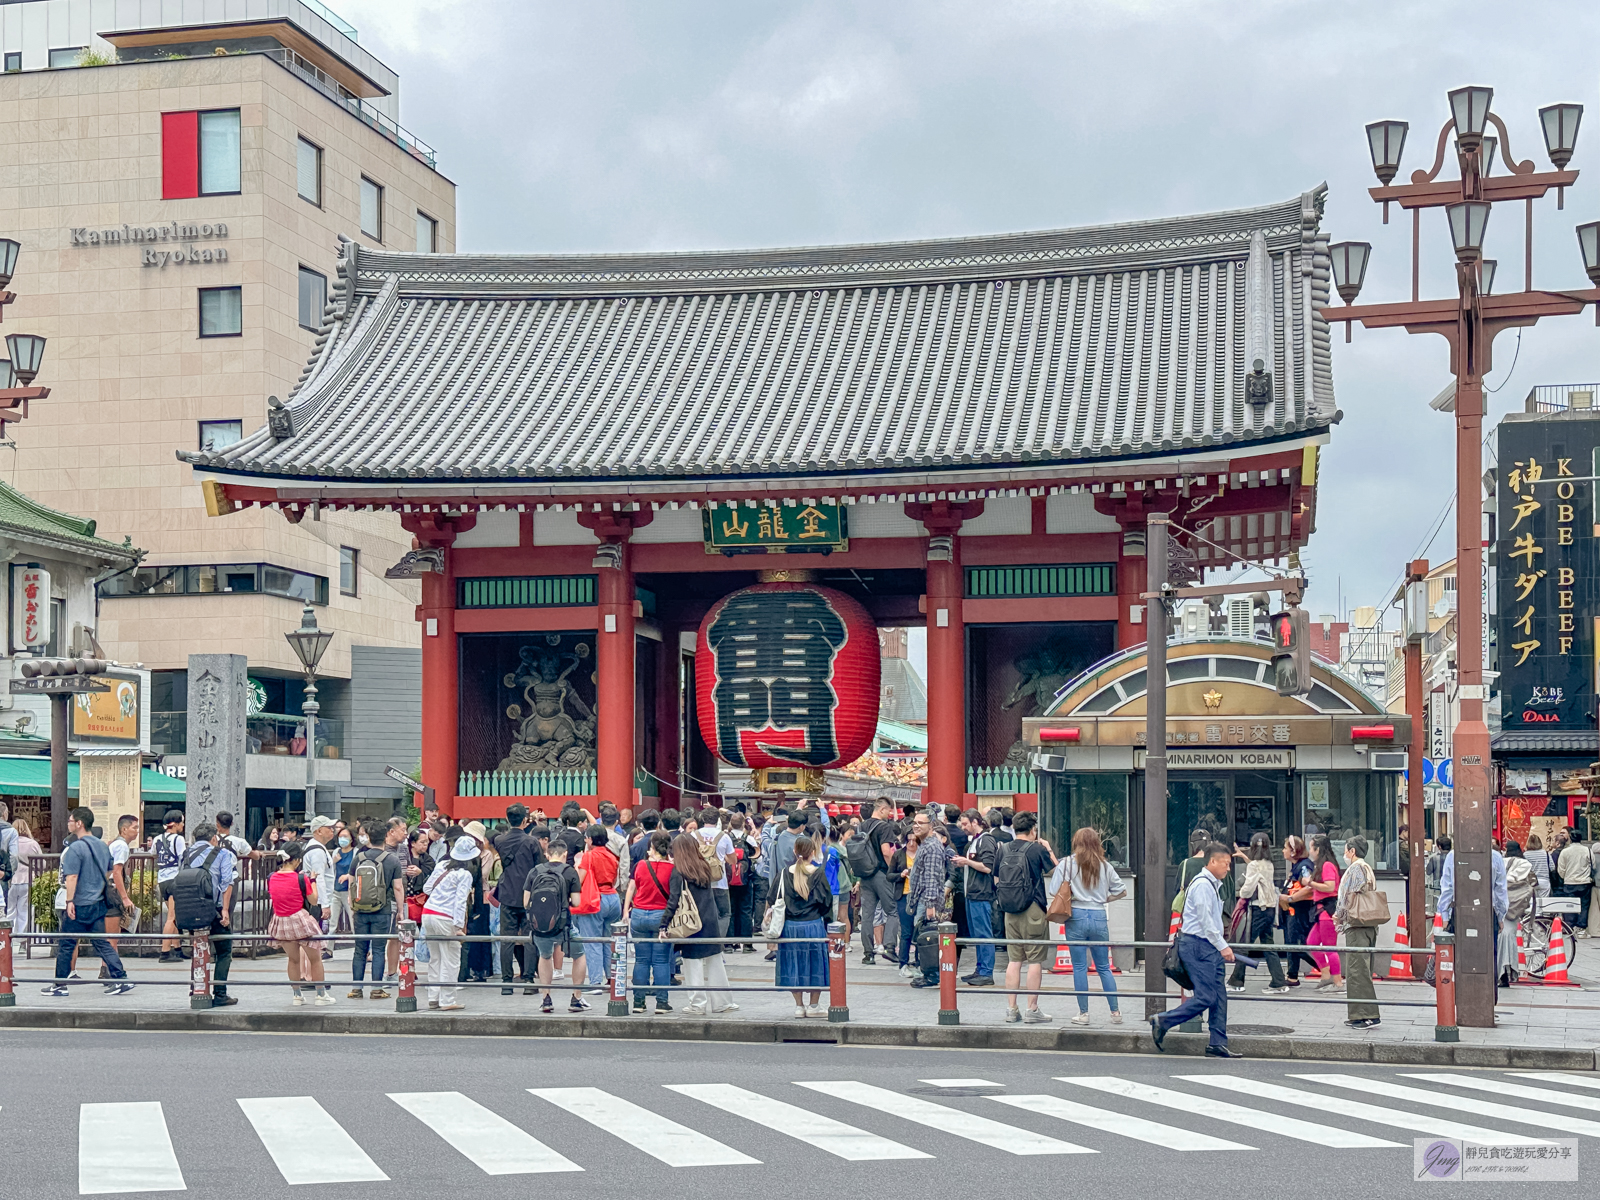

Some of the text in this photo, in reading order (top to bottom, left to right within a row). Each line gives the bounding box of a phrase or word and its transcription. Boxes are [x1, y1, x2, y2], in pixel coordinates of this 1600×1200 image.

[69, 220, 229, 246] Kaminarimon
[141, 243, 229, 269] Ryokan
[1508, 457, 1547, 667] 神戸牛ダイア
[1557, 458, 1575, 655] KOBE BEEF
[706, 588, 850, 767] 雷門
[1205, 724, 1291, 743] 雷門交番
[1166, 754, 1282, 764] MINARIMON KOBAN
